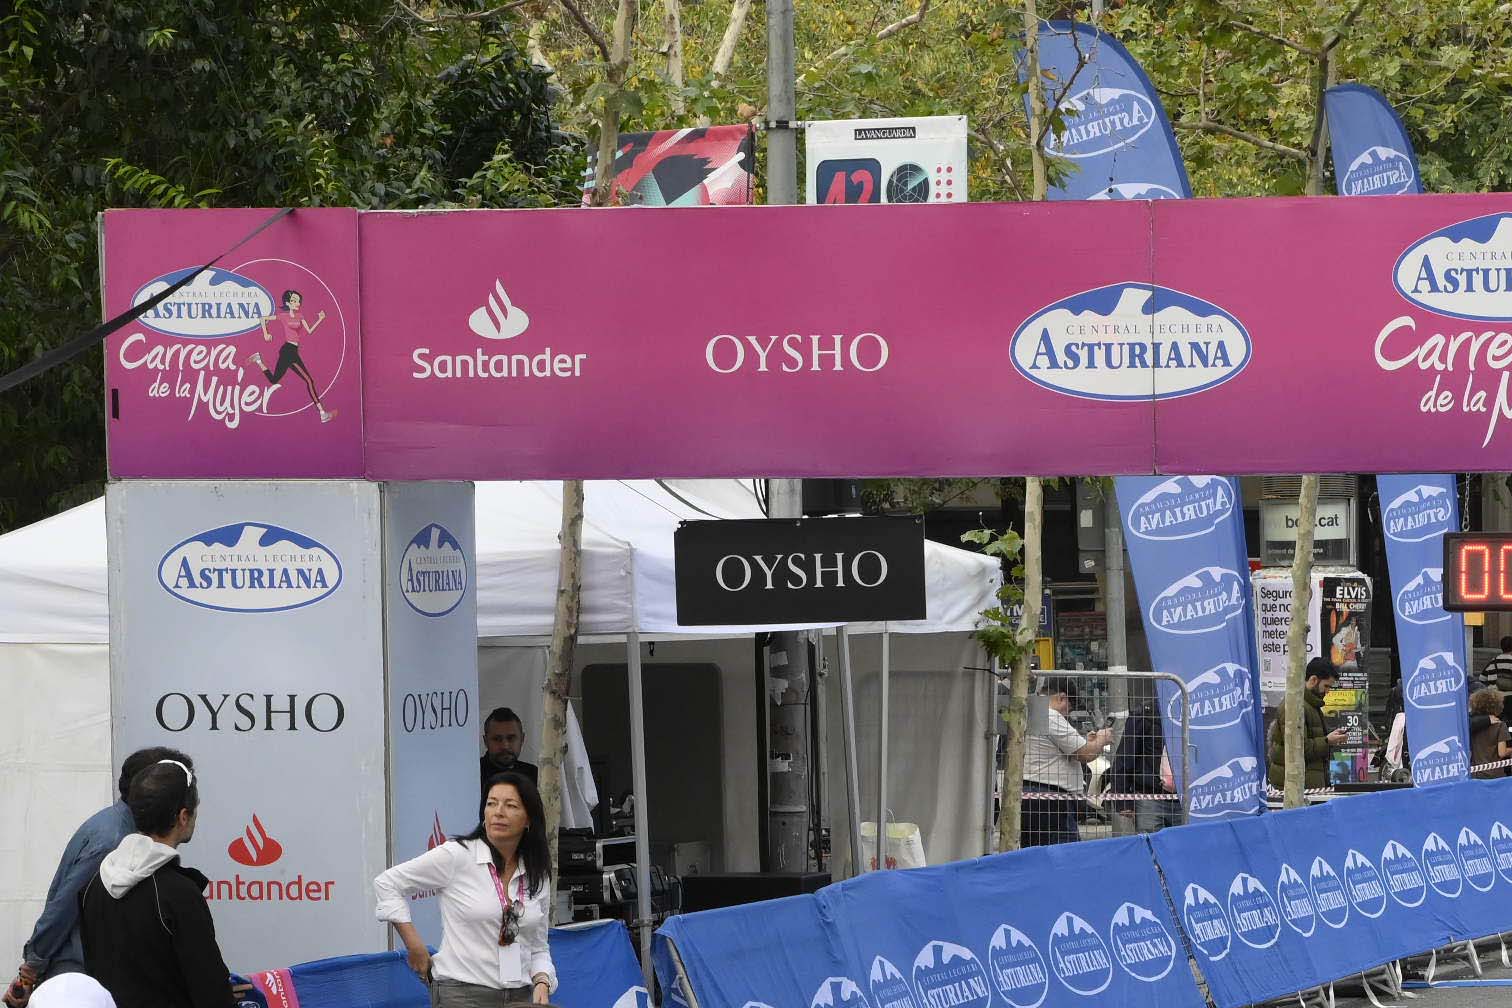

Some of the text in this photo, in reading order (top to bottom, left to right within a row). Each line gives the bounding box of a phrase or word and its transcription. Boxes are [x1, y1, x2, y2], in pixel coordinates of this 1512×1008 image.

[1066, 322, 1224, 335] CENTRAL LECHERA
[119, 333, 237, 370] Carrera
[412, 347, 587, 379] Santander
[705, 332, 889, 373] OYSHO
[1029, 327, 1232, 370] ASTURIANA
[148, 362, 282, 429] de la Mujer
[1420, 373, 1454, 413] de
[1463, 372, 1487, 413] la
[173, 555, 329, 590] ASTURIANA
[201, 553, 323, 563] CENTRAL LECHERA
[715, 550, 888, 592] OYSHO
[405, 558, 463, 594] ASTURIANA
[1336, 586, 1366, 599] ELVIS
[1261, 603, 1277, 613] que
[1261, 614, 1294, 626] quiere
[1262, 628, 1288, 640] mete
[1262, 642, 1281, 653] este
[155, 692, 345, 733] OYSHO
[402, 688, 469, 733] OYSHO
[1346, 715, 1359, 727] 30
